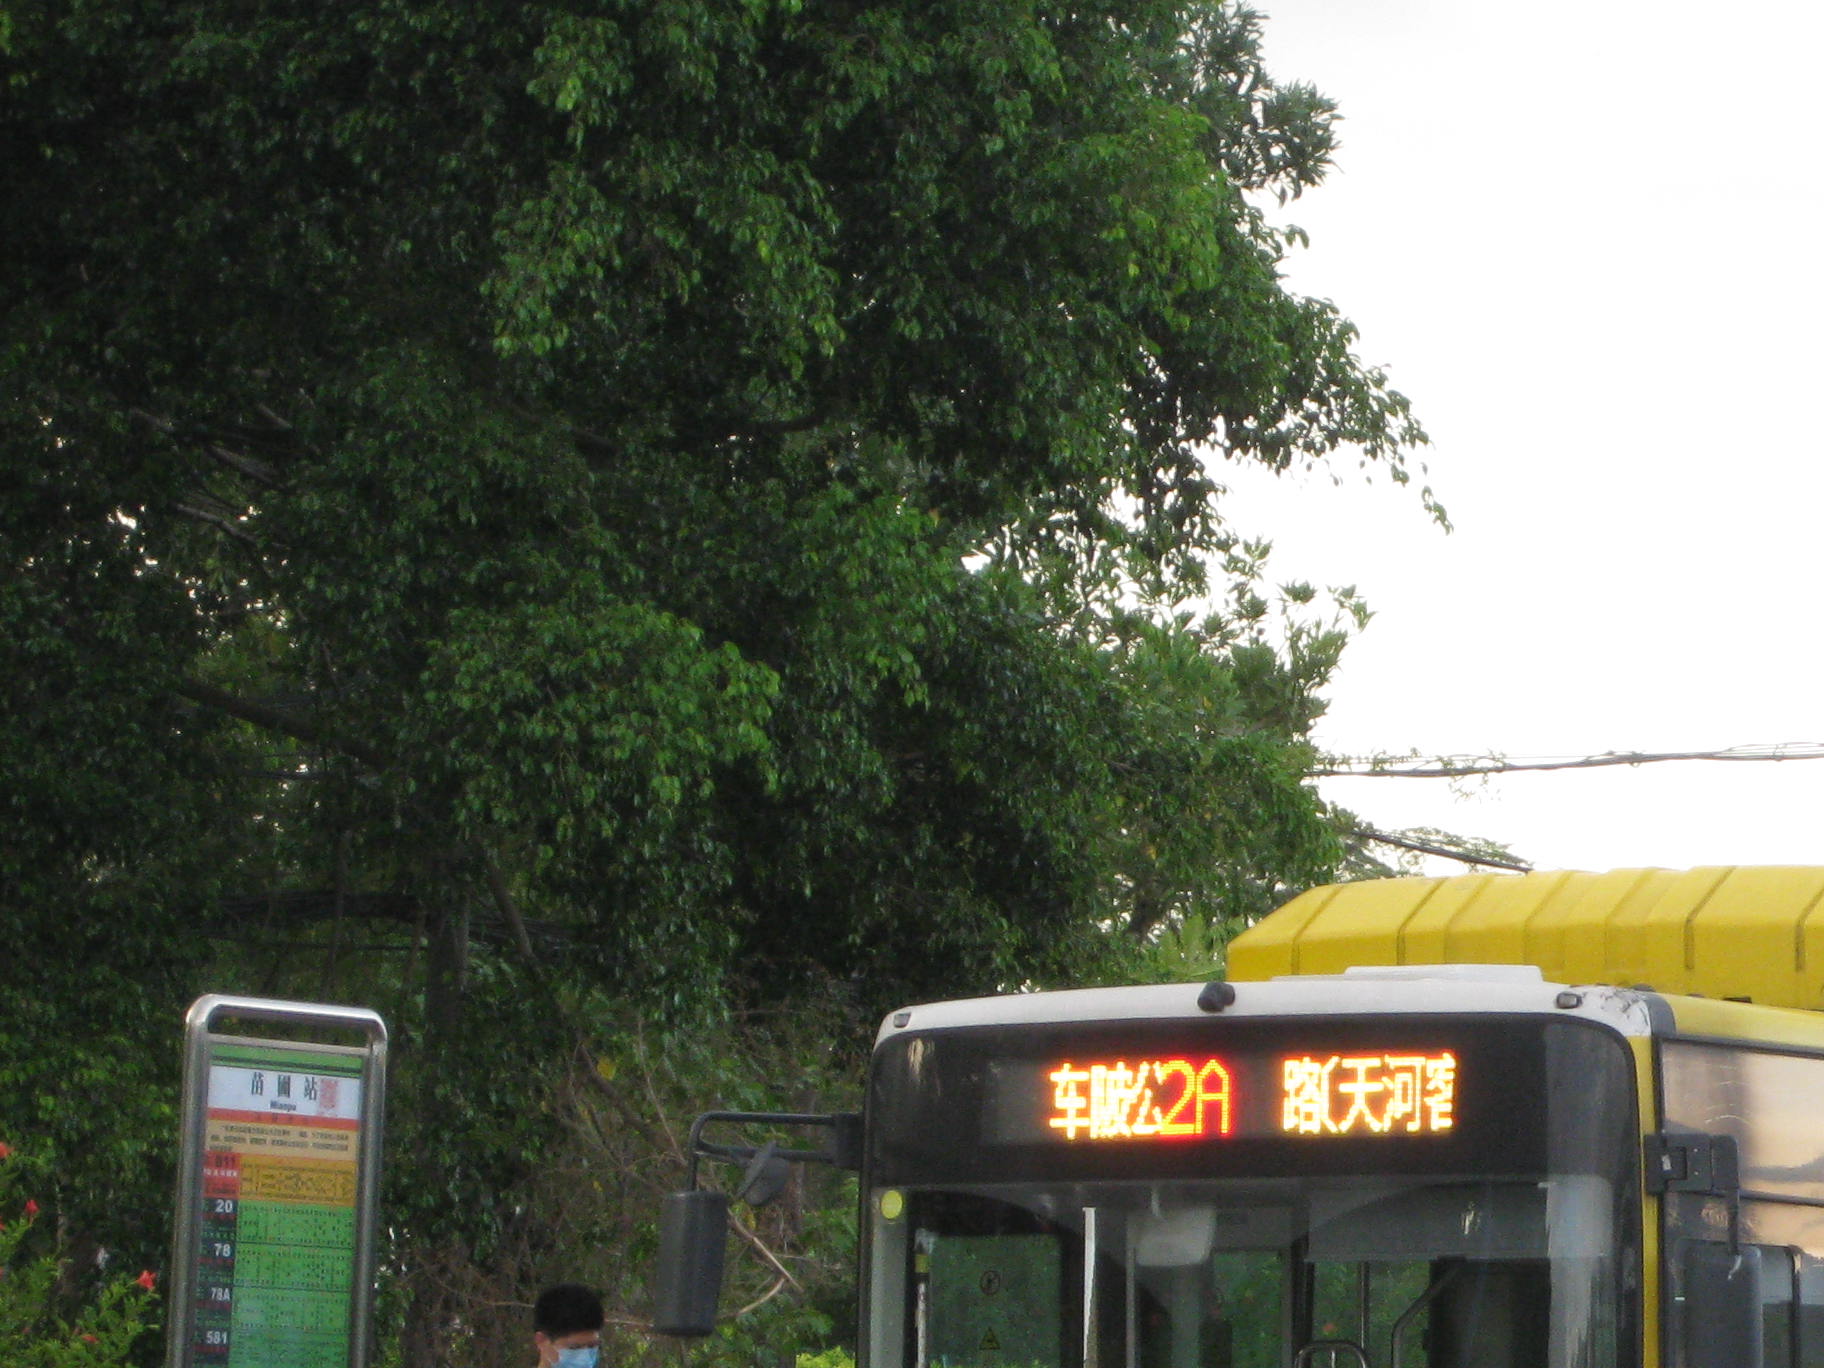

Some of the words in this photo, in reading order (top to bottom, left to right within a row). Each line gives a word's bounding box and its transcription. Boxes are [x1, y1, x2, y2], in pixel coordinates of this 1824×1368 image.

[215, 1199, 233, 1213] 20
[214, 1243, 231, 1257] 78
[210, 1287, 231, 1301] 78A
[206, 1330, 228, 1345] 581
